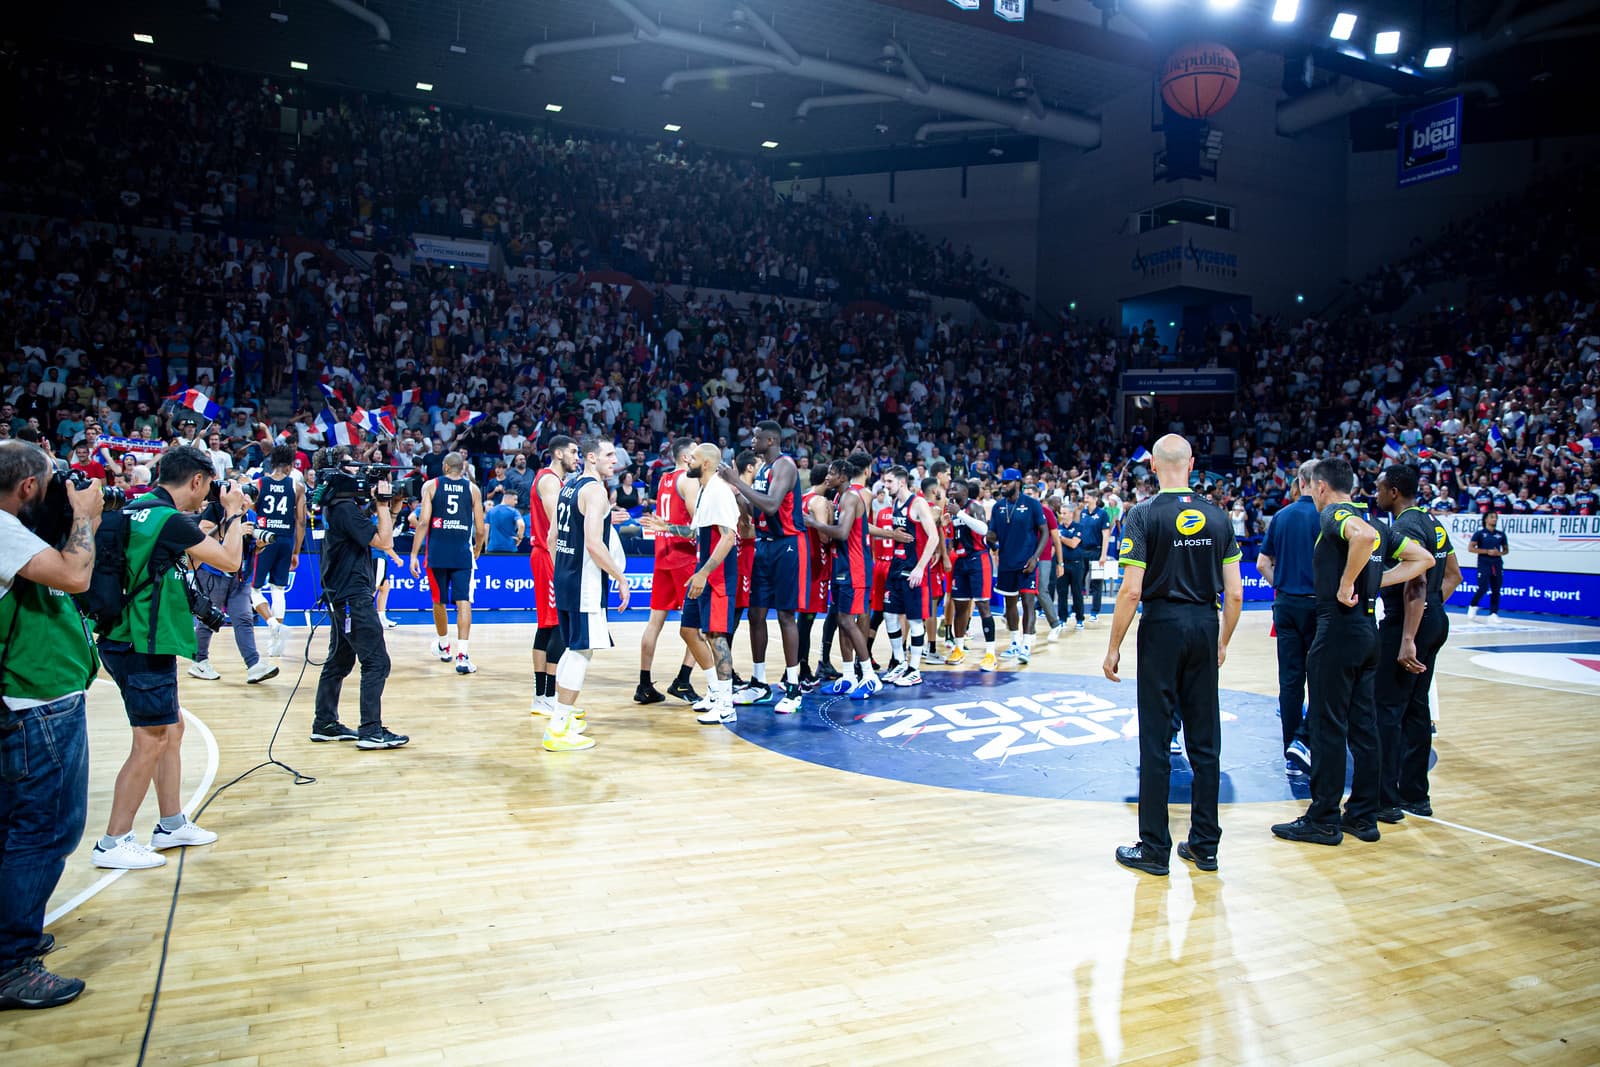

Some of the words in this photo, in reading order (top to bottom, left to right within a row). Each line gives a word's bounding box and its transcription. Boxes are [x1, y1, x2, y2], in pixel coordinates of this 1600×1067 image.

[1413, 123, 1455, 149] bleu
[263, 495, 288, 515] 34
[447, 494, 459, 514] 5
[1501, 519, 1556, 535] VAILLANT,
[1560, 517, 1588, 534] RIEN
[1173, 539, 1183, 547] LA
[1184, 538, 1212, 547] POSTE
[485, 575, 500, 590] le
[505, 577, 535, 593] spo
[1455, 581, 1480, 593] aire
[1529, 586, 1541, 598] le
[1544, 589, 1581, 602] sport
[863, 690, 1117, 739] 2013
